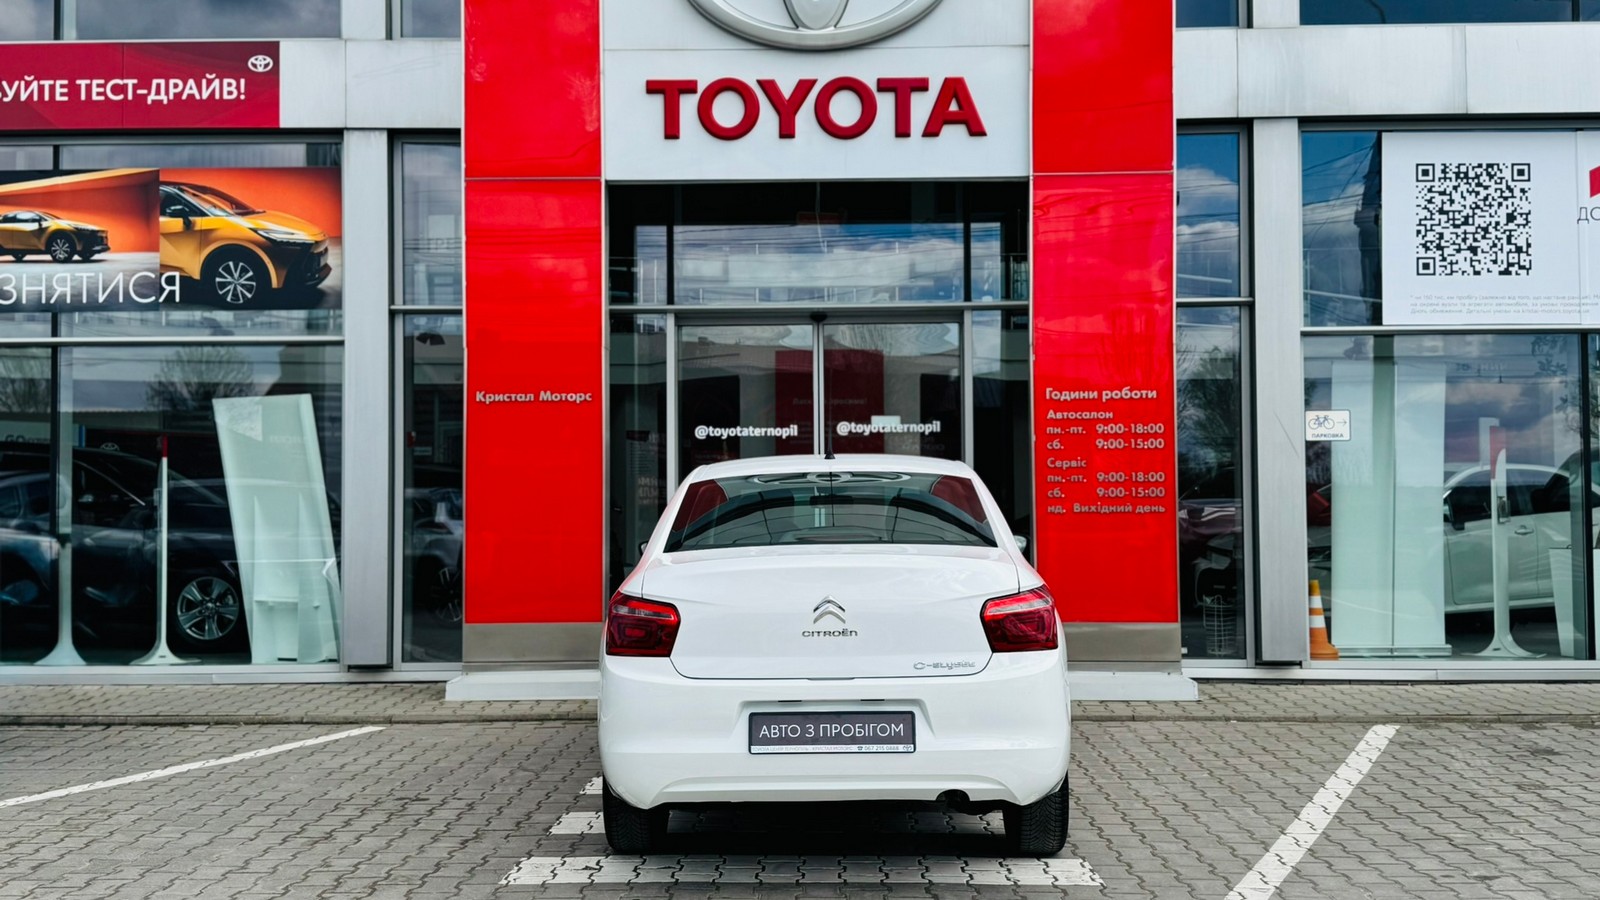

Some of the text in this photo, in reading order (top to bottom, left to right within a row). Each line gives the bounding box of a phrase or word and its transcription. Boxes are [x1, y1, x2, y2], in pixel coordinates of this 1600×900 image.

[0, 73, 247, 104] УЙТЕ ТЕСТ-ДРАЙВ!
[645, 76, 988, 141] TOYOTA
[0, 271, 181, 305] ЗНЯТИСЯ
[476, 390, 592, 404] Кристал Моторс
[1046, 386, 1158, 402] Години роботи
[1046, 410, 1114, 420] Автосалон
[694, 425, 798, 440] @toyotaternopil
[836, 420, 941, 436] @toyotaternopil
[1046, 438, 1064, 450] сб.
[1046, 457, 1087, 470] Сервіс
[1048, 488, 1065, 498] сб.
[1048, 502, 1166, 514] нд. Вихідний день
[759, 723, 904, 738] АВТО З ПРОБІГОМ
